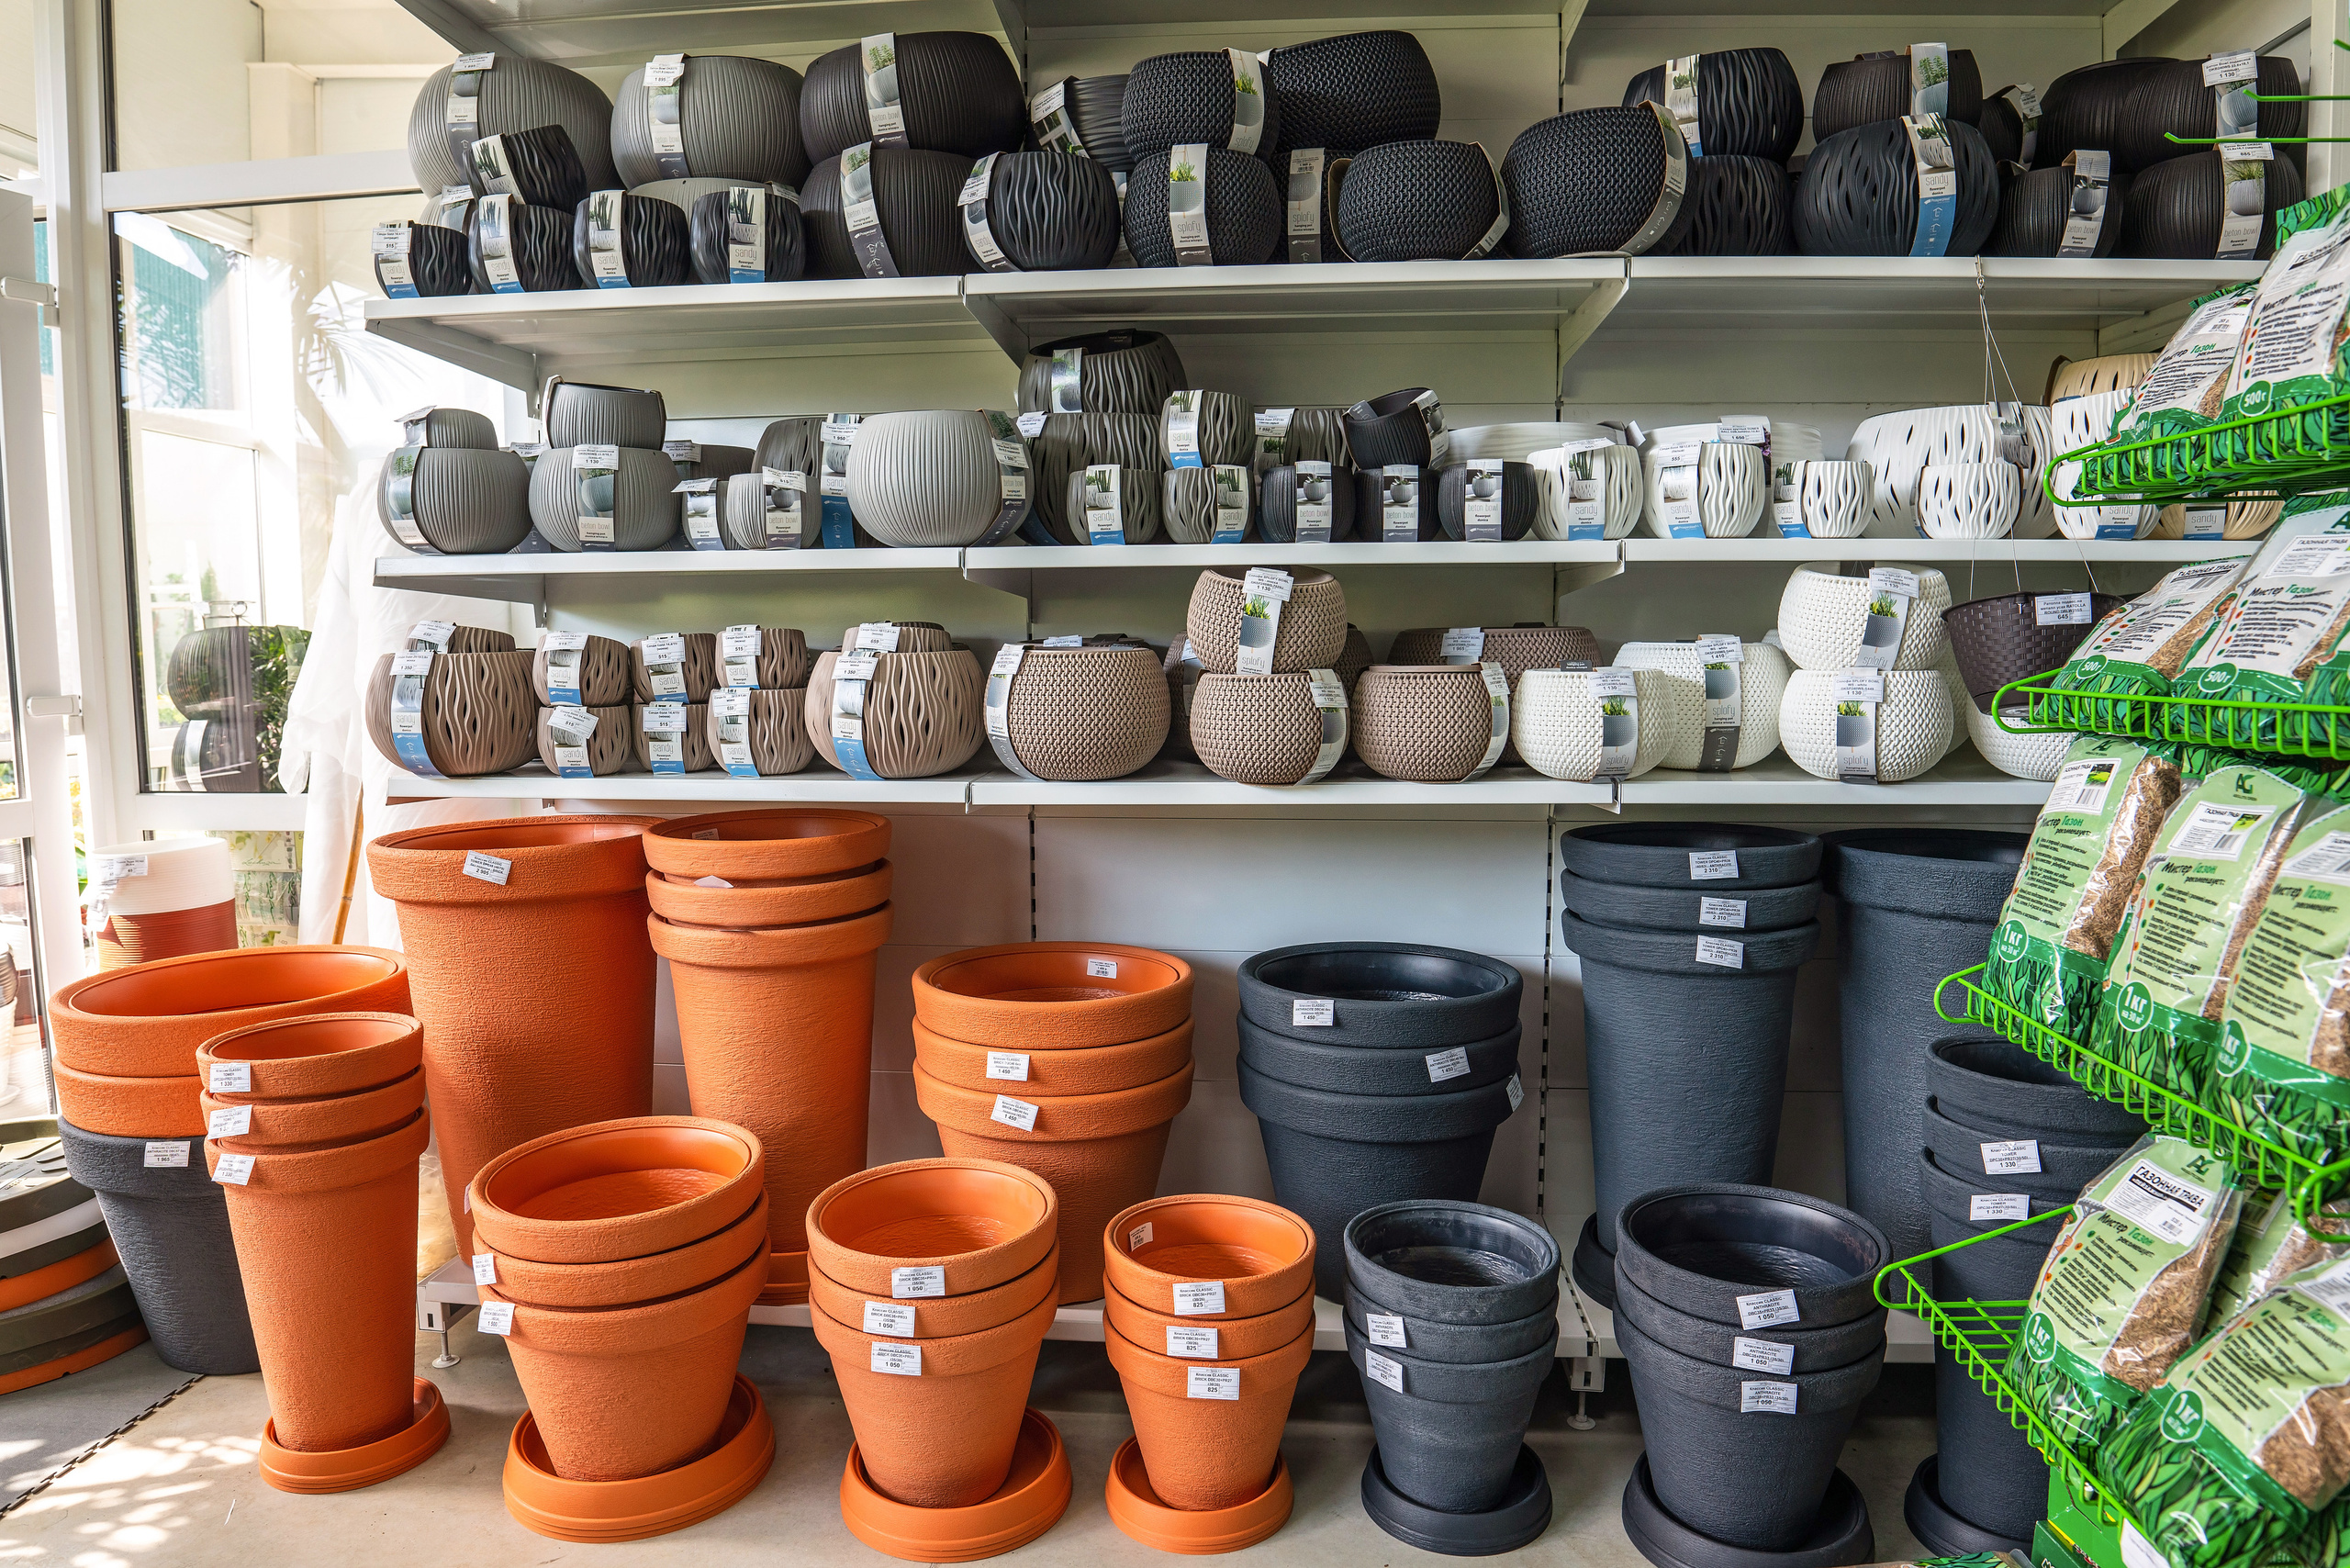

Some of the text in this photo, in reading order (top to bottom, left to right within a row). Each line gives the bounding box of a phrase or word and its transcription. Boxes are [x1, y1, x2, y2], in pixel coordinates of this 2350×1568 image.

[1925, 174, 1949, 186] sandy
[1292, 212, 1315, 225] splofy
[1178, 221, 1201, 234] splofy
[2066, 225, 2098, 234] beton bowl
[2224, 227, 2257, 238] beton bowl
[599, 255, 618, 266] sandy
[734, 248, 756, 261] sandy
[386, 263, 405, 275] sandy
[2189, 343, 2217, 354] Газон
[2244, 390, 2266, 408] 500г
[1173, 431, 1192, 442] sandy
[1404, 510, 1416, 519] bowl
[1575, 505, 1597, 516] sandy
[1671, 503, 1692, 515] sandy
[2109, 505, 2133, 517] sandy
[1092, 511, 1114, 522] sandy
[1223, 511, 1242, 522] sandy
[2191, 511, 2217, 523] sandy
[2248, 587, 2285, 597] Мистер
[2285, 584, 2317, 594] Газон
[1241, 655, 1265, 668] splofy
[1863, 655, 1888, 668] splofy
[2081, 659, 2102, 673] 500г
[659, 676, 679, 688] sandy
[2207, 669, 2232, 683] 500г
[1713, 704, 1736, 716] splofy
[653, 744, 674, 754] sandy
[1606, 754, 1629, 766] splofy
[1843, 756, 1868, 766] splofy
[2062, 815, 2084, 826] Газон
[2162, 862, 2218, 876] Мистер Газон
[2136, 1165, 2206, 1207] ГАЗОННАЯ ТРАВА
[2098, 1213, 2154, 1246] Мистер Газон
